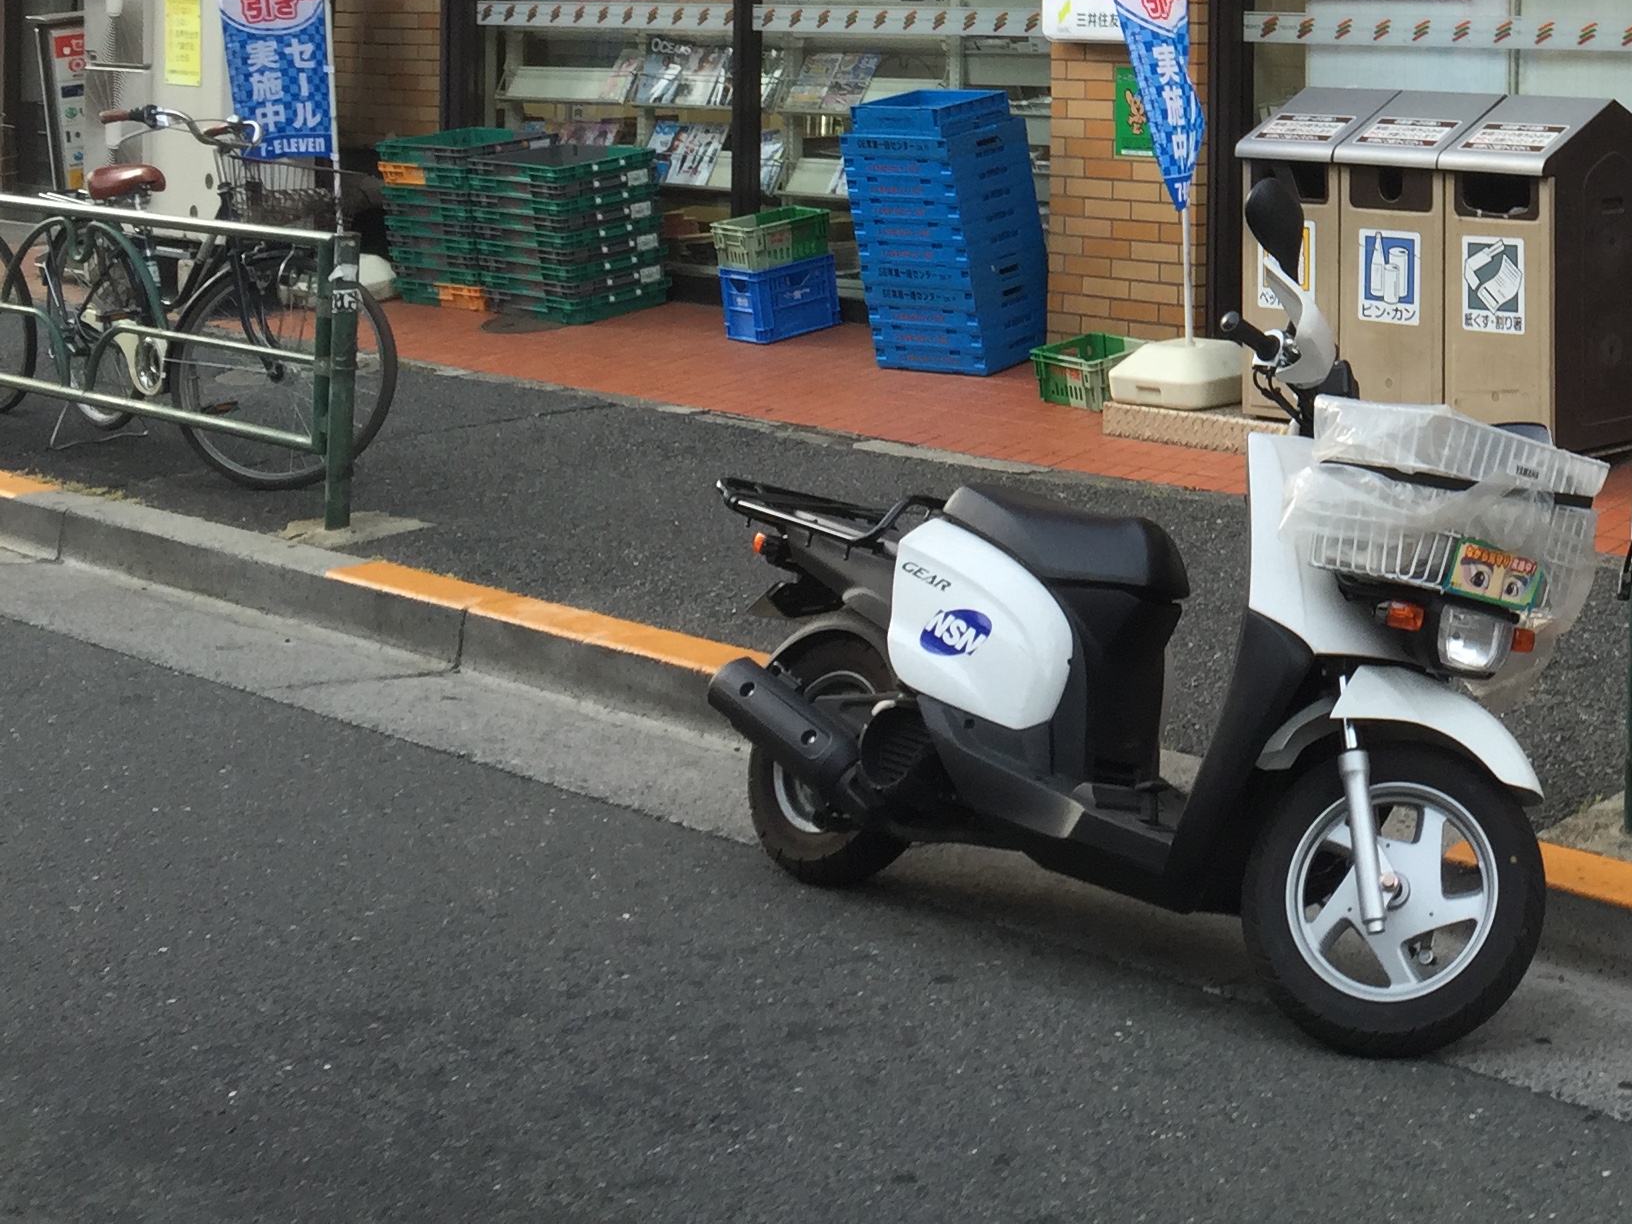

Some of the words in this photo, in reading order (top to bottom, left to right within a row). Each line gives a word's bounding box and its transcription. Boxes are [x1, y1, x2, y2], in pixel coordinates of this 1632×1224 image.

[246, 40, 287, 132] 実施中
[284, 38, 322, 131] セール
[1361, 304, 1417, 322] ビン・カン
[1464, 313, 1523, 333] 紙くず・割り箸
[902, 561, 951, 591] GEAR
[925, 609, 987, 656] NSN
